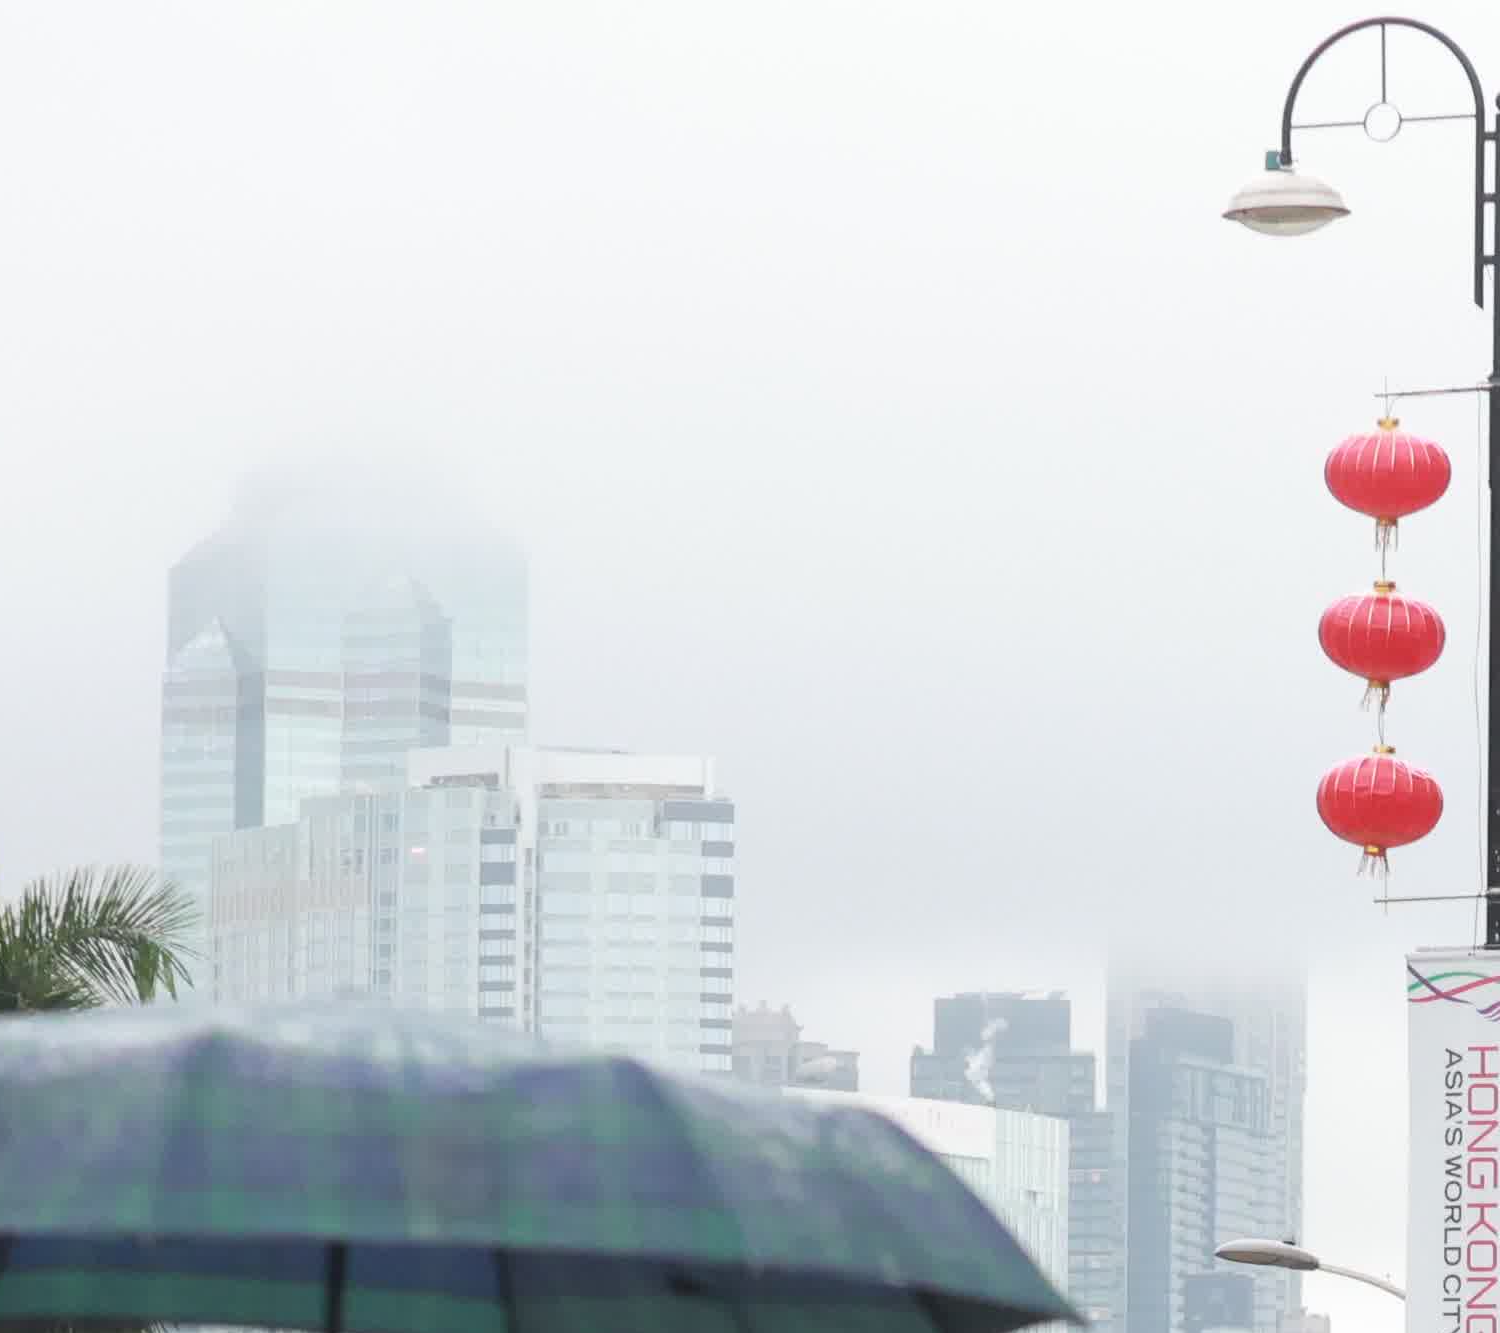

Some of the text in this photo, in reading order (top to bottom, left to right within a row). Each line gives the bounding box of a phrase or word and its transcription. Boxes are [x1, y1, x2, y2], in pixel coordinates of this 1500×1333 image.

[1444, 1048, 1463, 1146] ASIA'S
[1467, 1046, 1499, 1189] HONG
[1443, 1155, 1462, 1266] WORLD
